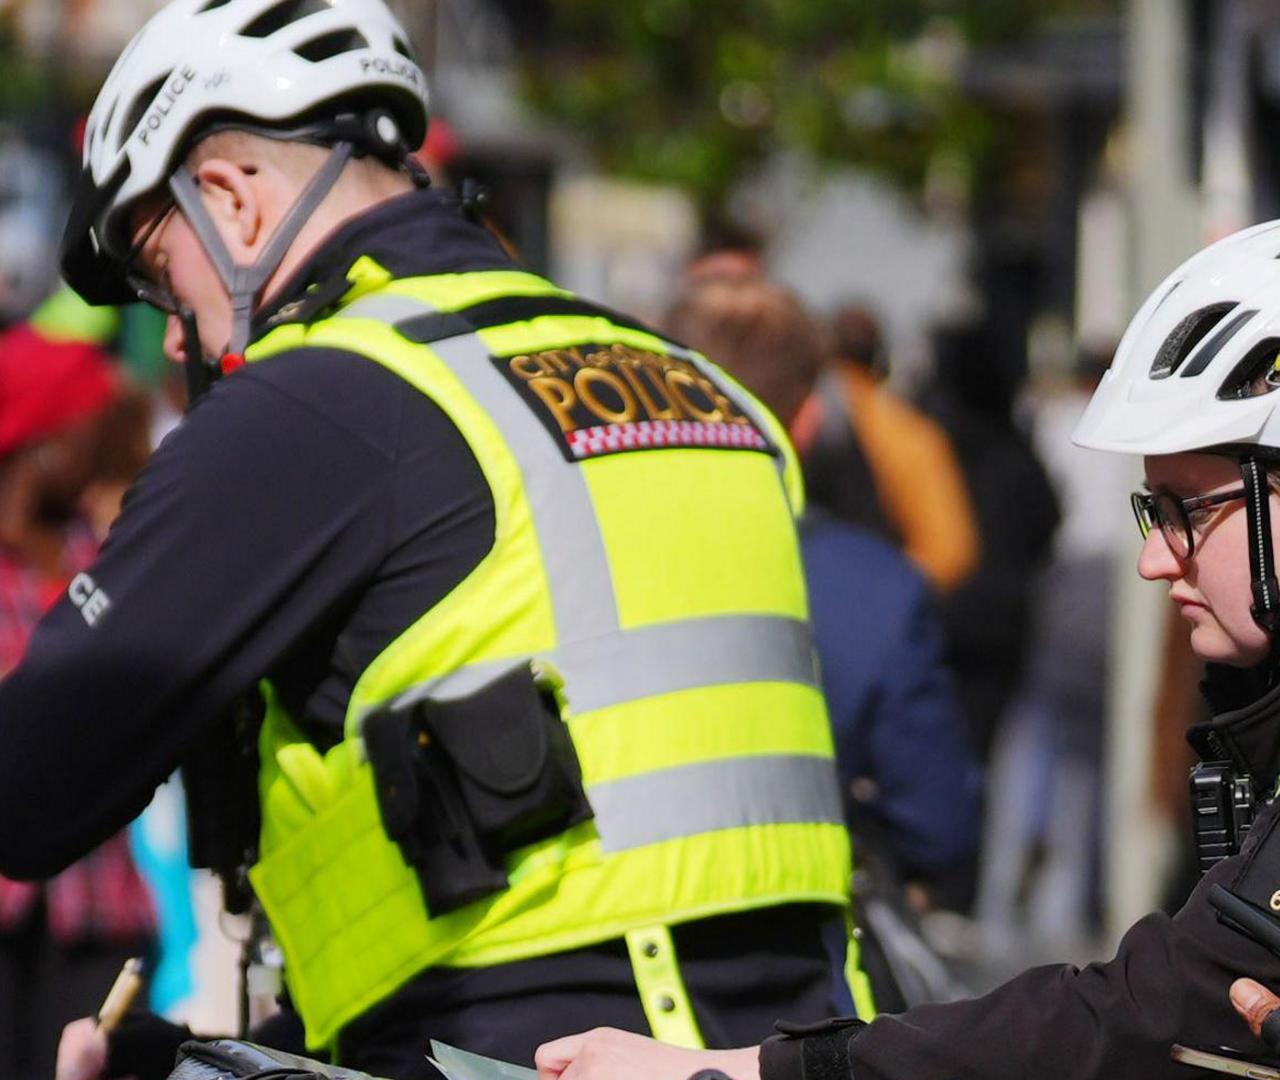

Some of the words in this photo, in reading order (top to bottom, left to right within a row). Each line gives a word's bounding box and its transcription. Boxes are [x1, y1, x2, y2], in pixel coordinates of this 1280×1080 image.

[358, 58, 419, 85] POLICE
[138, 65, 197, 147] POLICE
[510, 347, 585, 379] CITY
[527, 366, 751, 434] POLICE
